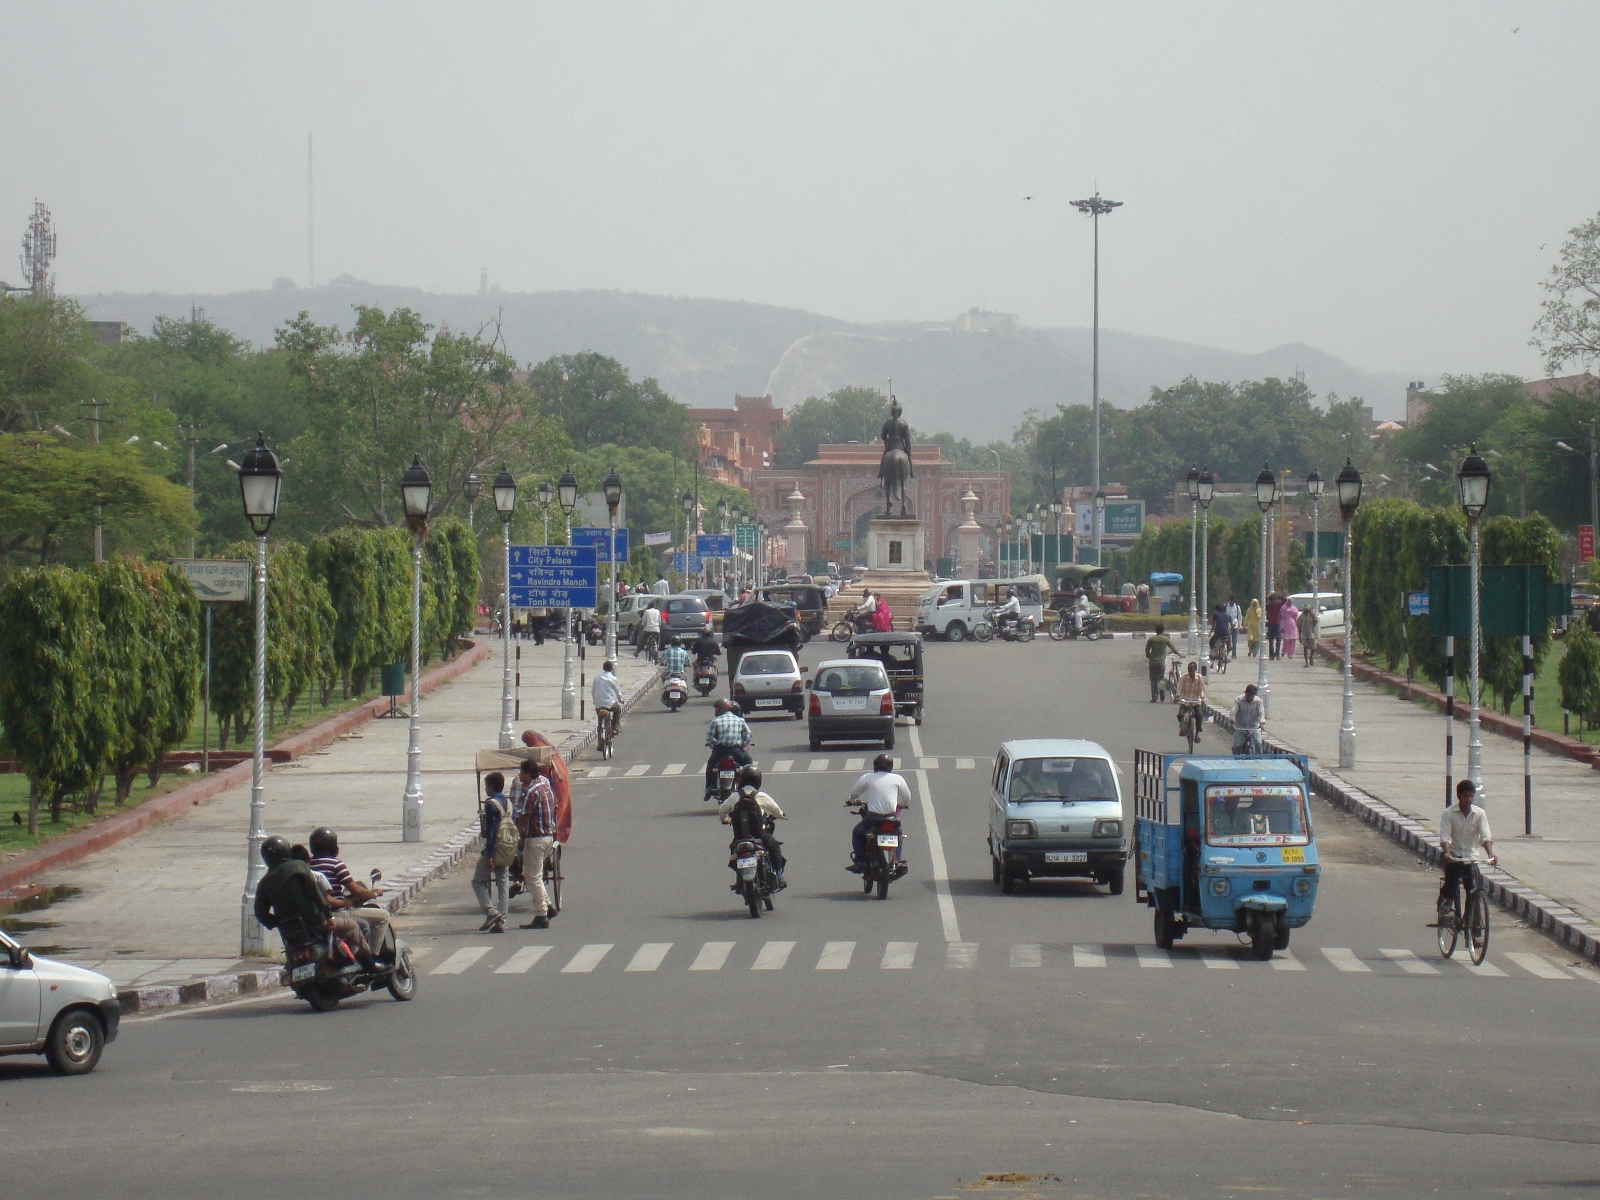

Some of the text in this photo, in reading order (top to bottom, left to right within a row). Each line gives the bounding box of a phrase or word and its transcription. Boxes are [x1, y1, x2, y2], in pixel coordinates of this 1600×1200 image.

[528, 556, 572, 565] City Palace
[527, 577, 588, 586] Ravindra Manch
[528, 598, 571, 606] Tonk Road
[1071, 854, 1087, 862] 3227
